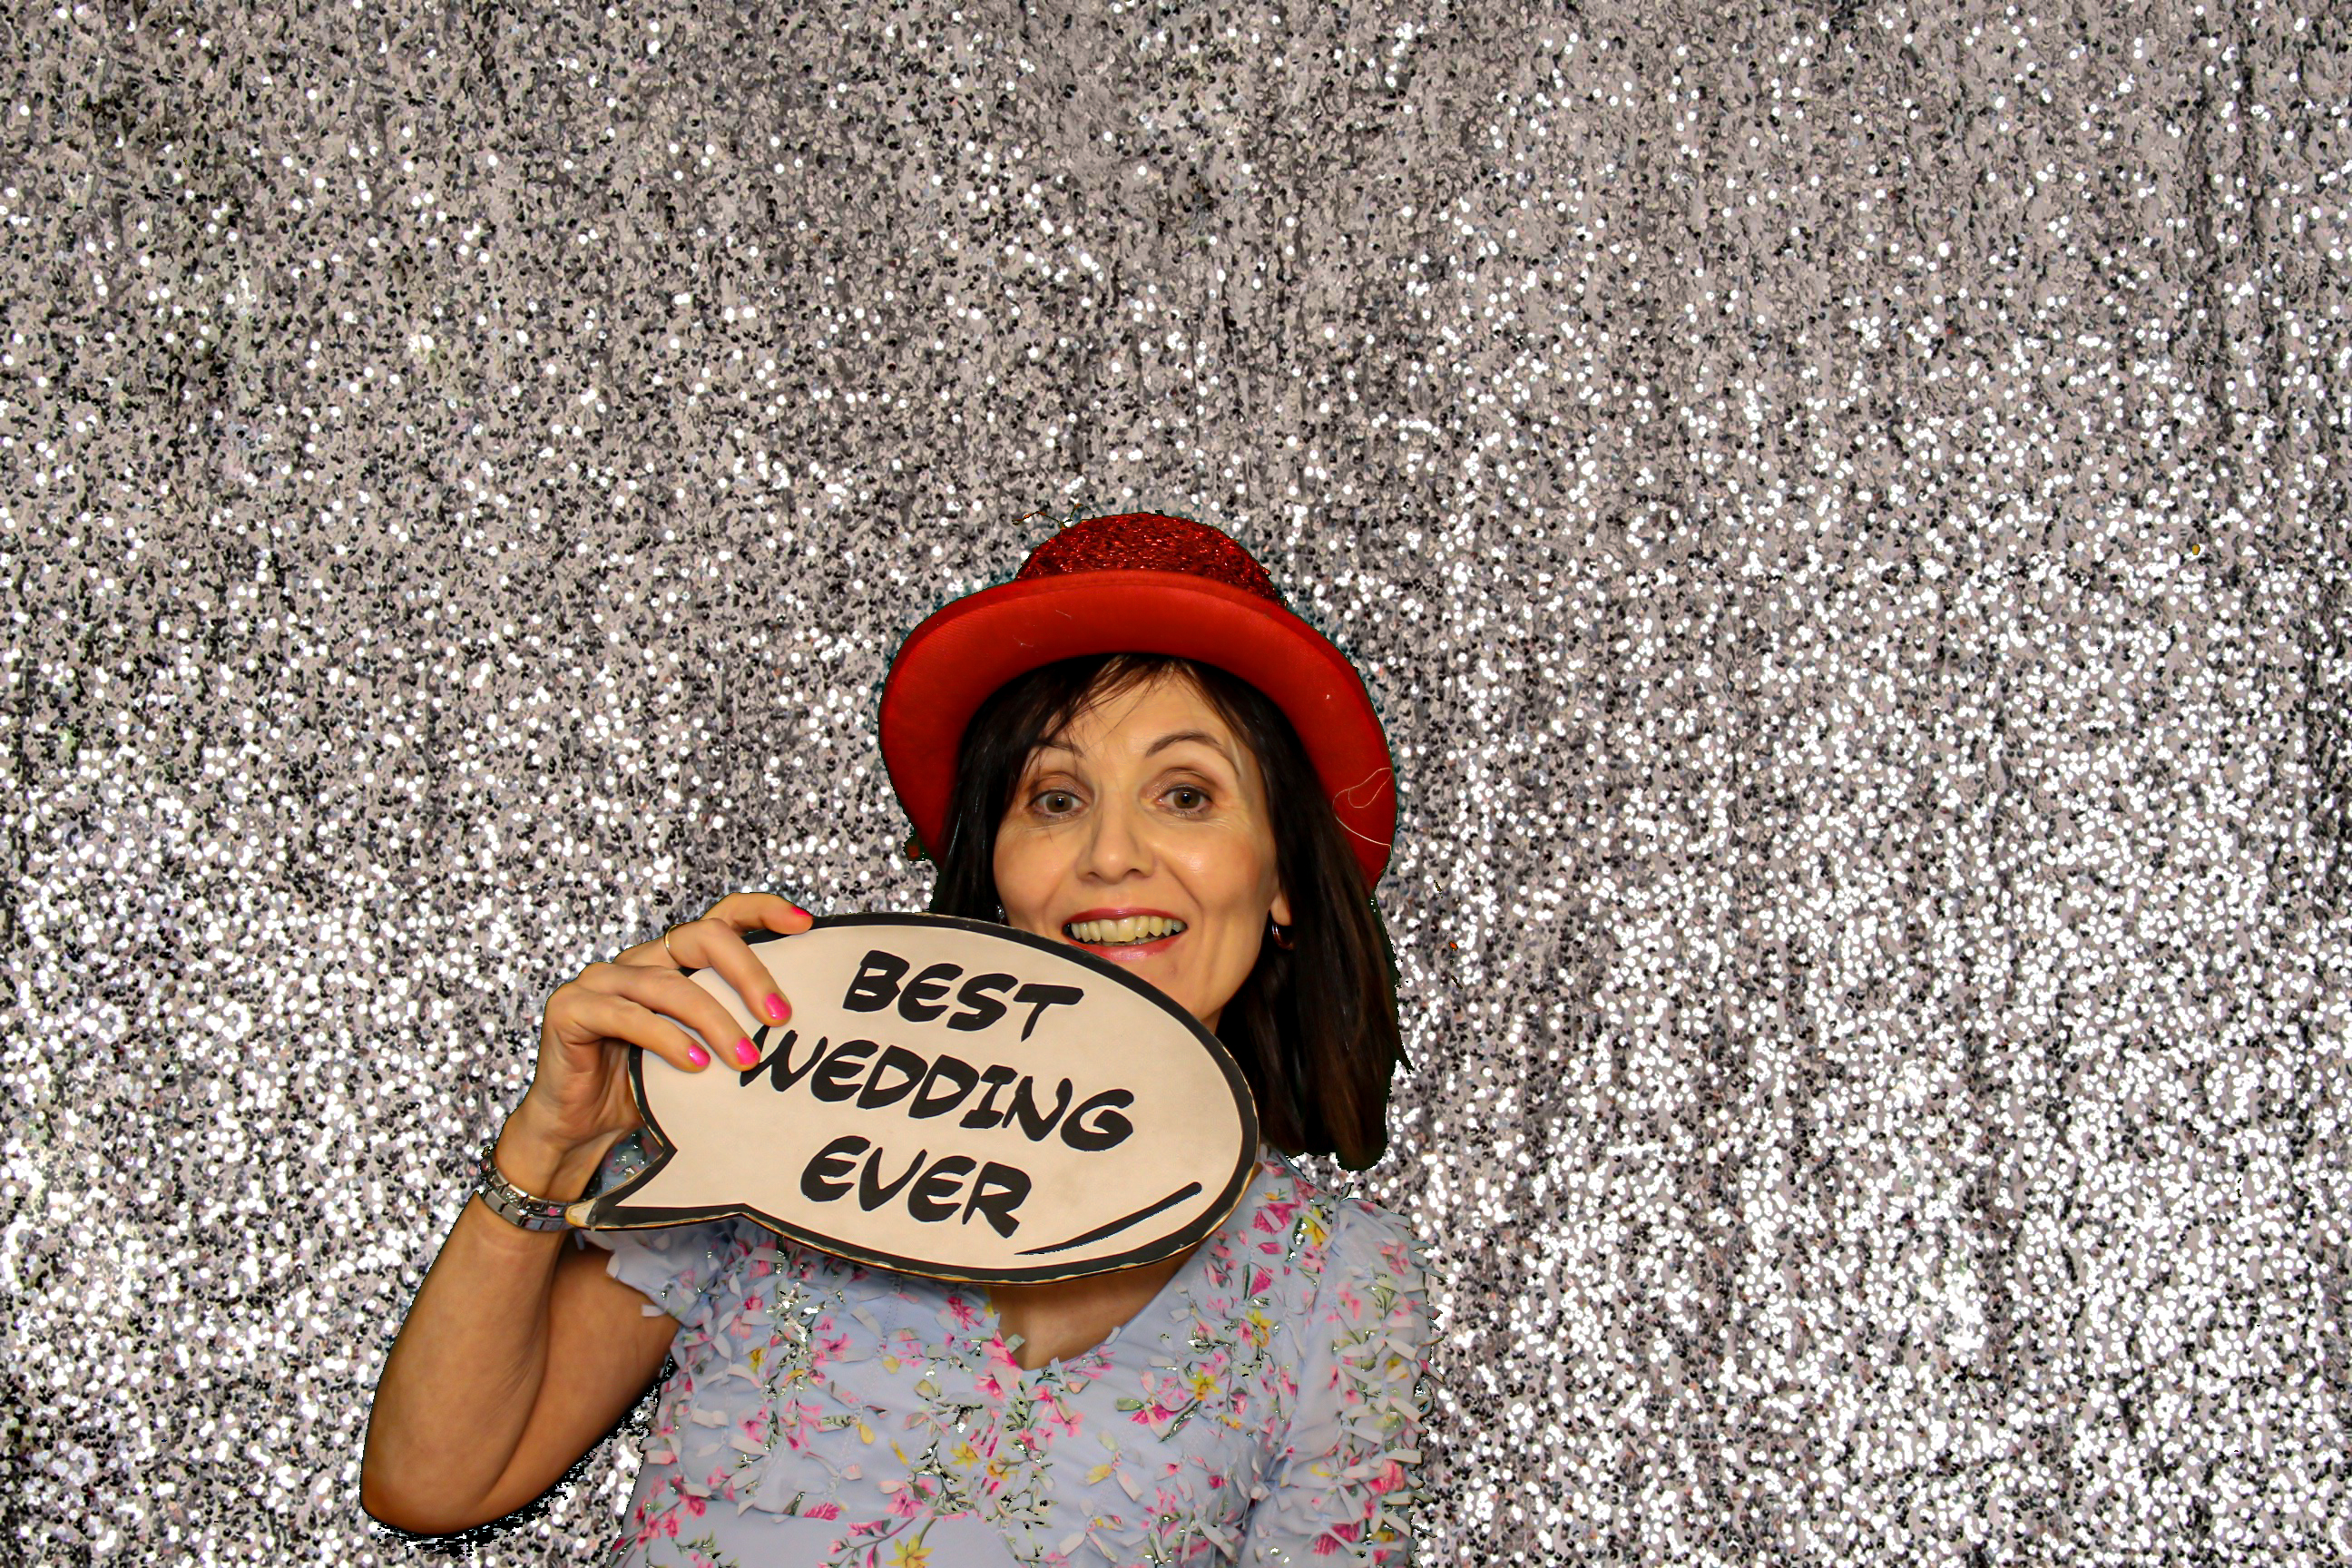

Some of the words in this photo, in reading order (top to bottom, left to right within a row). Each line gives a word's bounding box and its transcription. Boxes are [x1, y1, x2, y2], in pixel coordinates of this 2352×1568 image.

[843, 949, 1084, 1042] BEST
[740, 1024, 1134, 1152] WEDDING
[800, 1135, 1033, 1239] EVER
